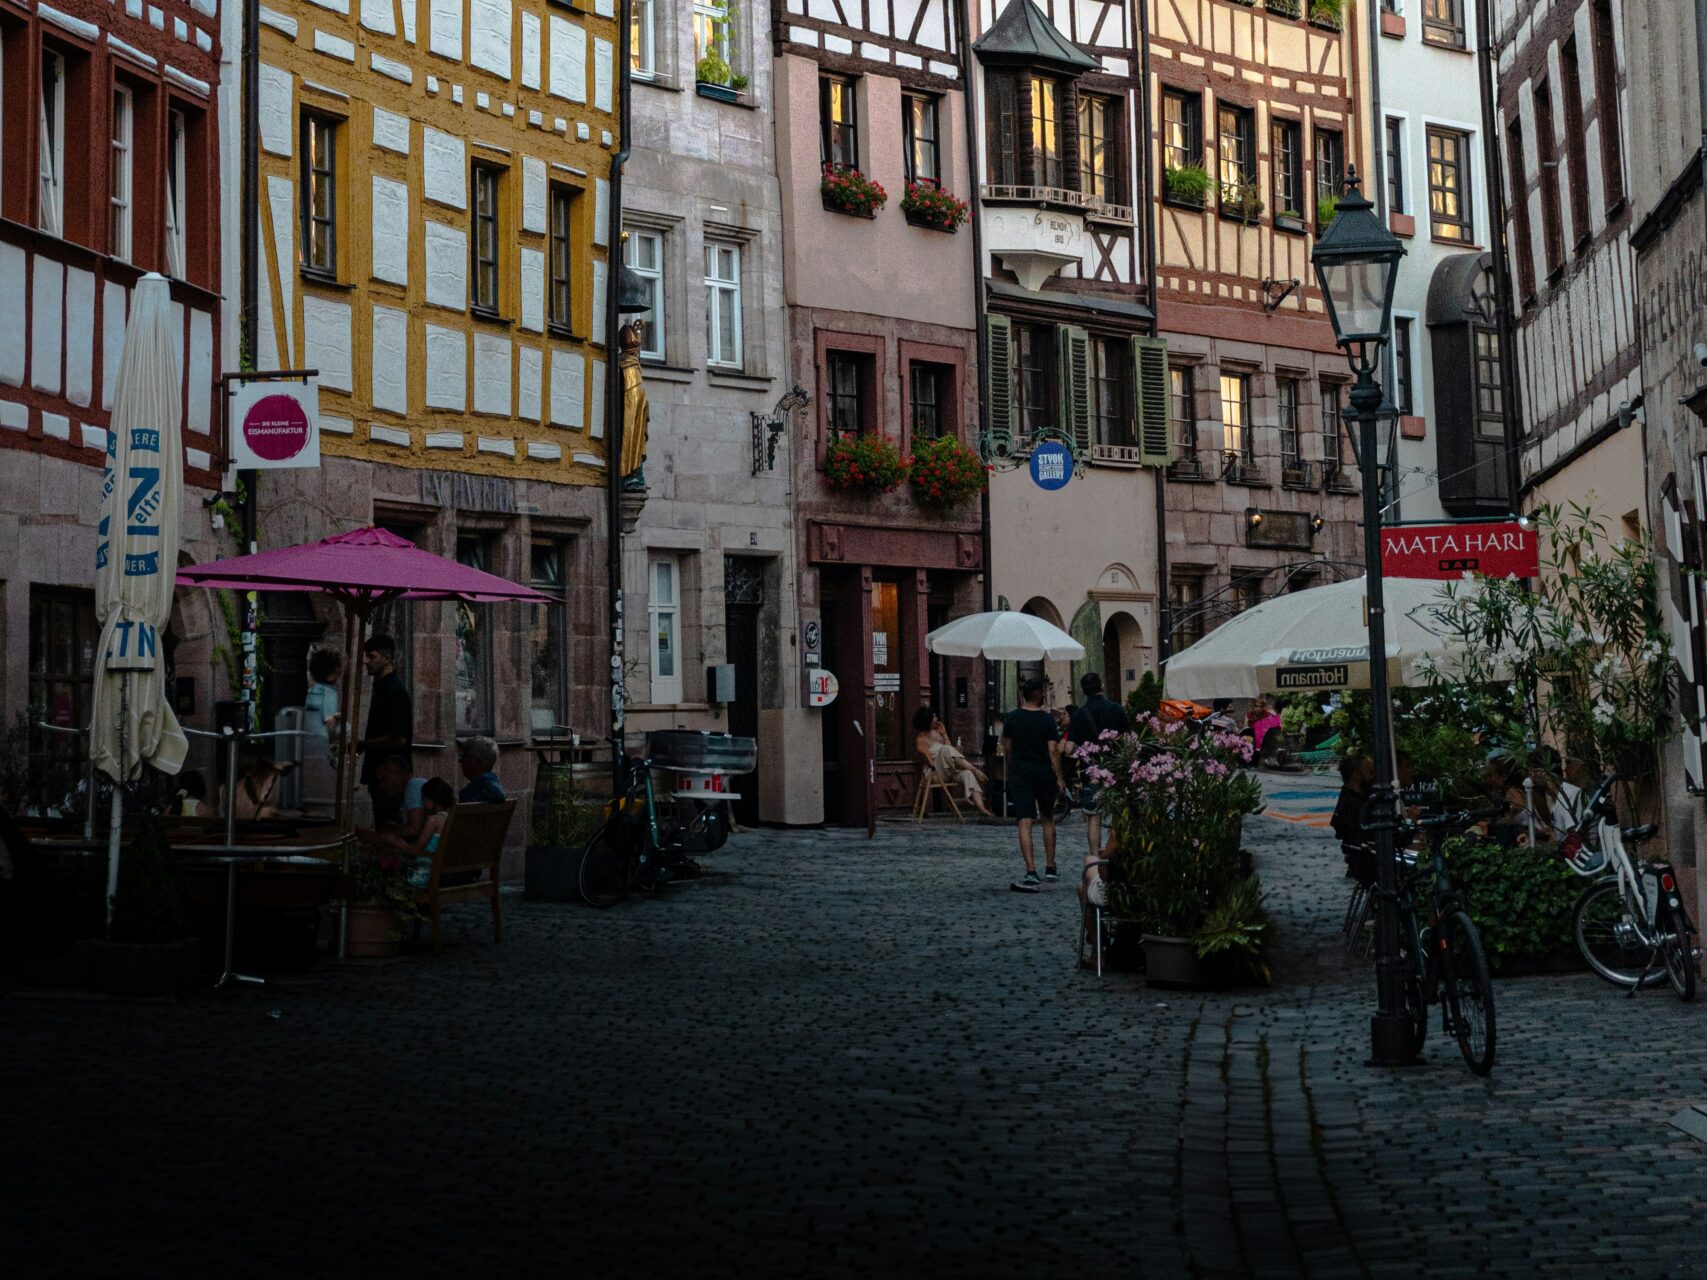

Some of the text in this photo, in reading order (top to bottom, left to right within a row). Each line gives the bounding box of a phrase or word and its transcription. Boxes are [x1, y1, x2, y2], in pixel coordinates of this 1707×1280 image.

[248, 427, 303, 435] EISMANUFAKTUR
[1038, 470, 1064, 481] GALLERY
[1385, 532, 1526, 557] MATA HARI
[1440, 560, 1477, 569] BAR
